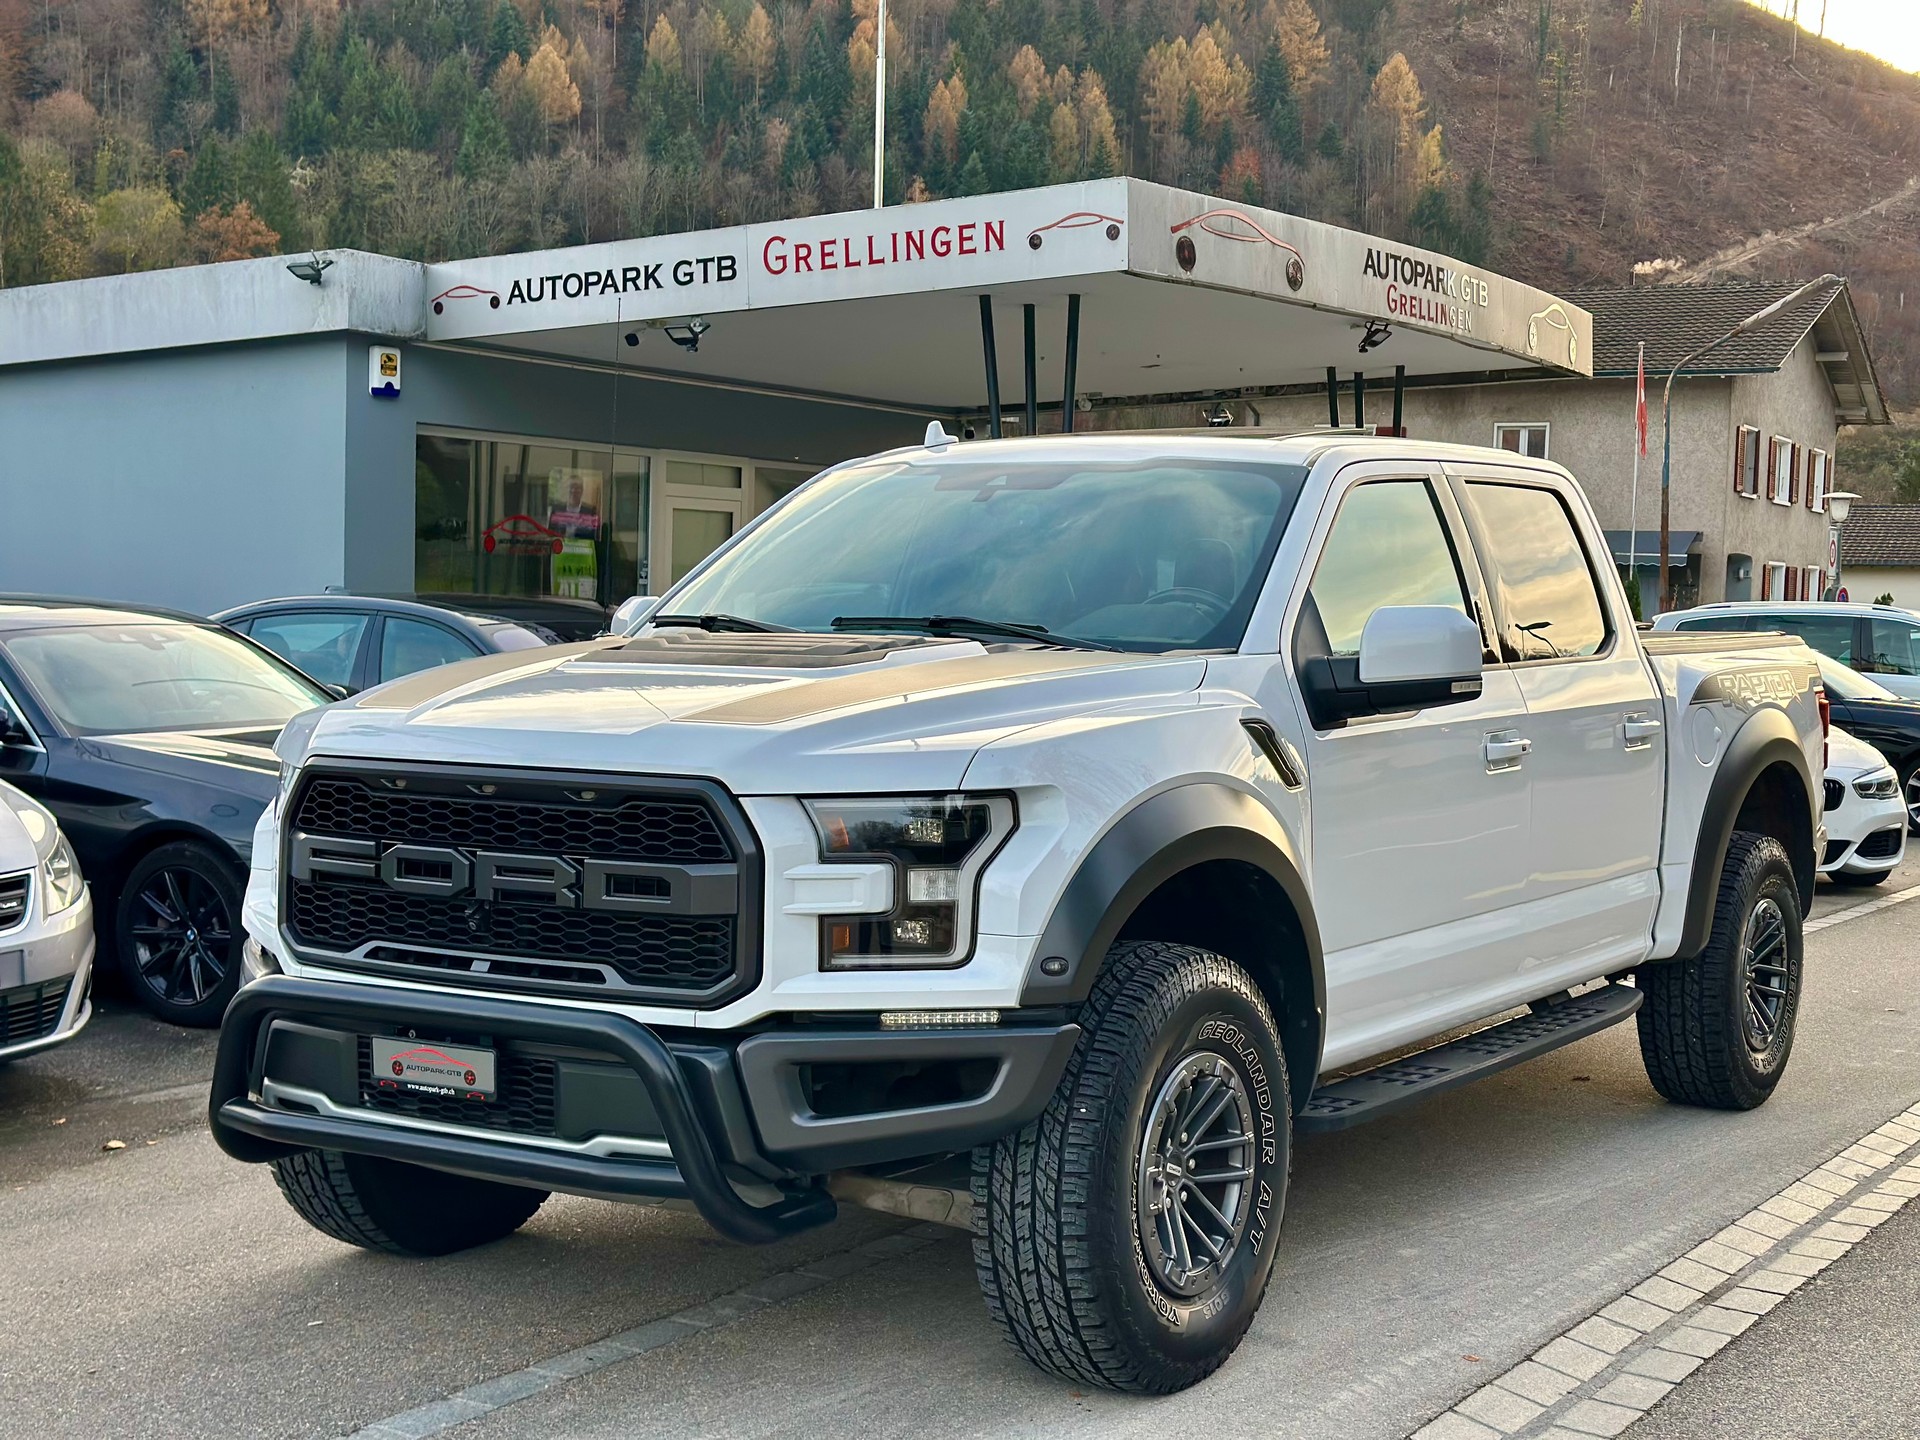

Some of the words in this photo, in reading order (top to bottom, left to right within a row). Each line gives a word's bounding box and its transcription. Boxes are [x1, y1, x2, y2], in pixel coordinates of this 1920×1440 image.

[507, 263, 664, 306] AUTOPARK
[672, 254, 738, 287] GTB
[1363, 247, 1457, 298] AUTOPARK
[1460, 273, 1489, 308] GTB
[1716, 669, 1802, 713] RAPTOR
[291, 832, 738, 915] FORD
[1197, 1019, 1276, 1165] GEOLANDAR
[1249, 1179, 1273, 1256] A/T
